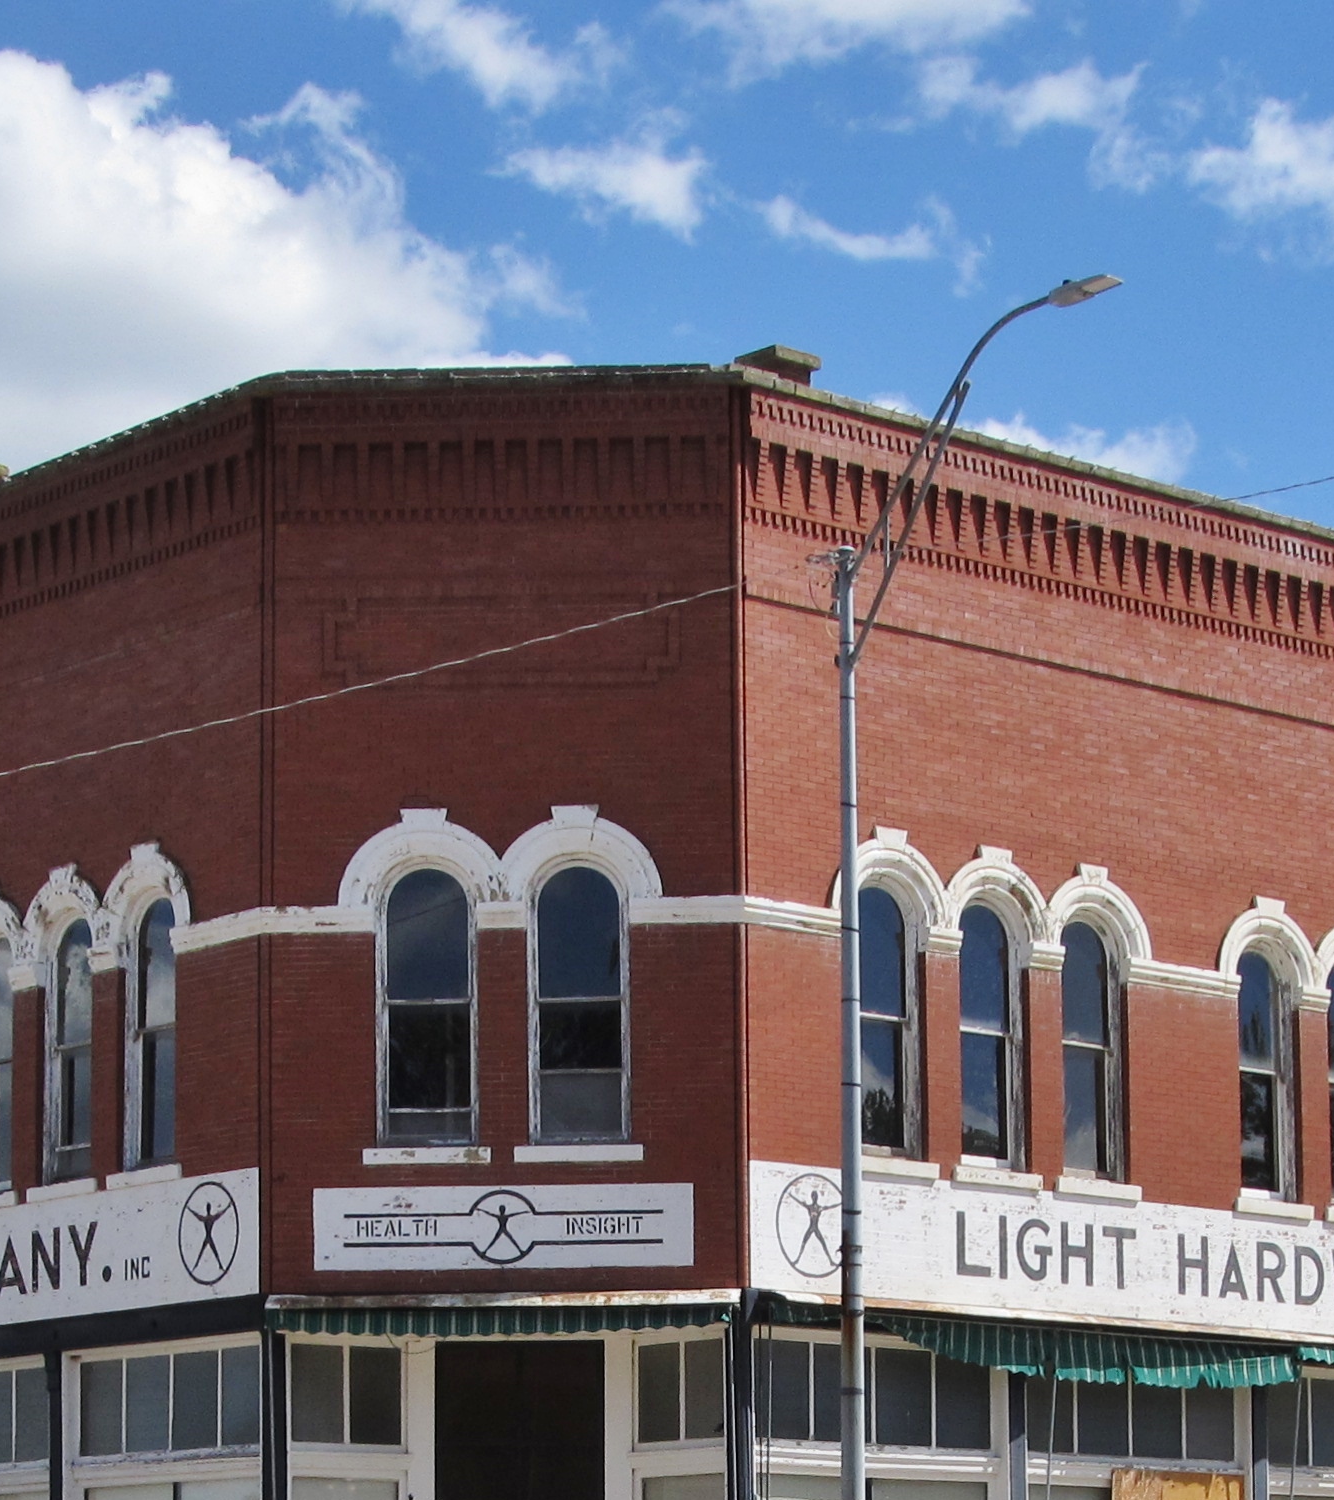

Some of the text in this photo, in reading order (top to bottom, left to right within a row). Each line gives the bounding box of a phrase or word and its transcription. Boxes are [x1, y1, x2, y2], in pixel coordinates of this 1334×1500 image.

[356, 1216, 644, 1238] HEALTH INSIGHT
[955, 1210, 1137, 1291] LIGHT
[124, 1256, 151, 1281] INC
